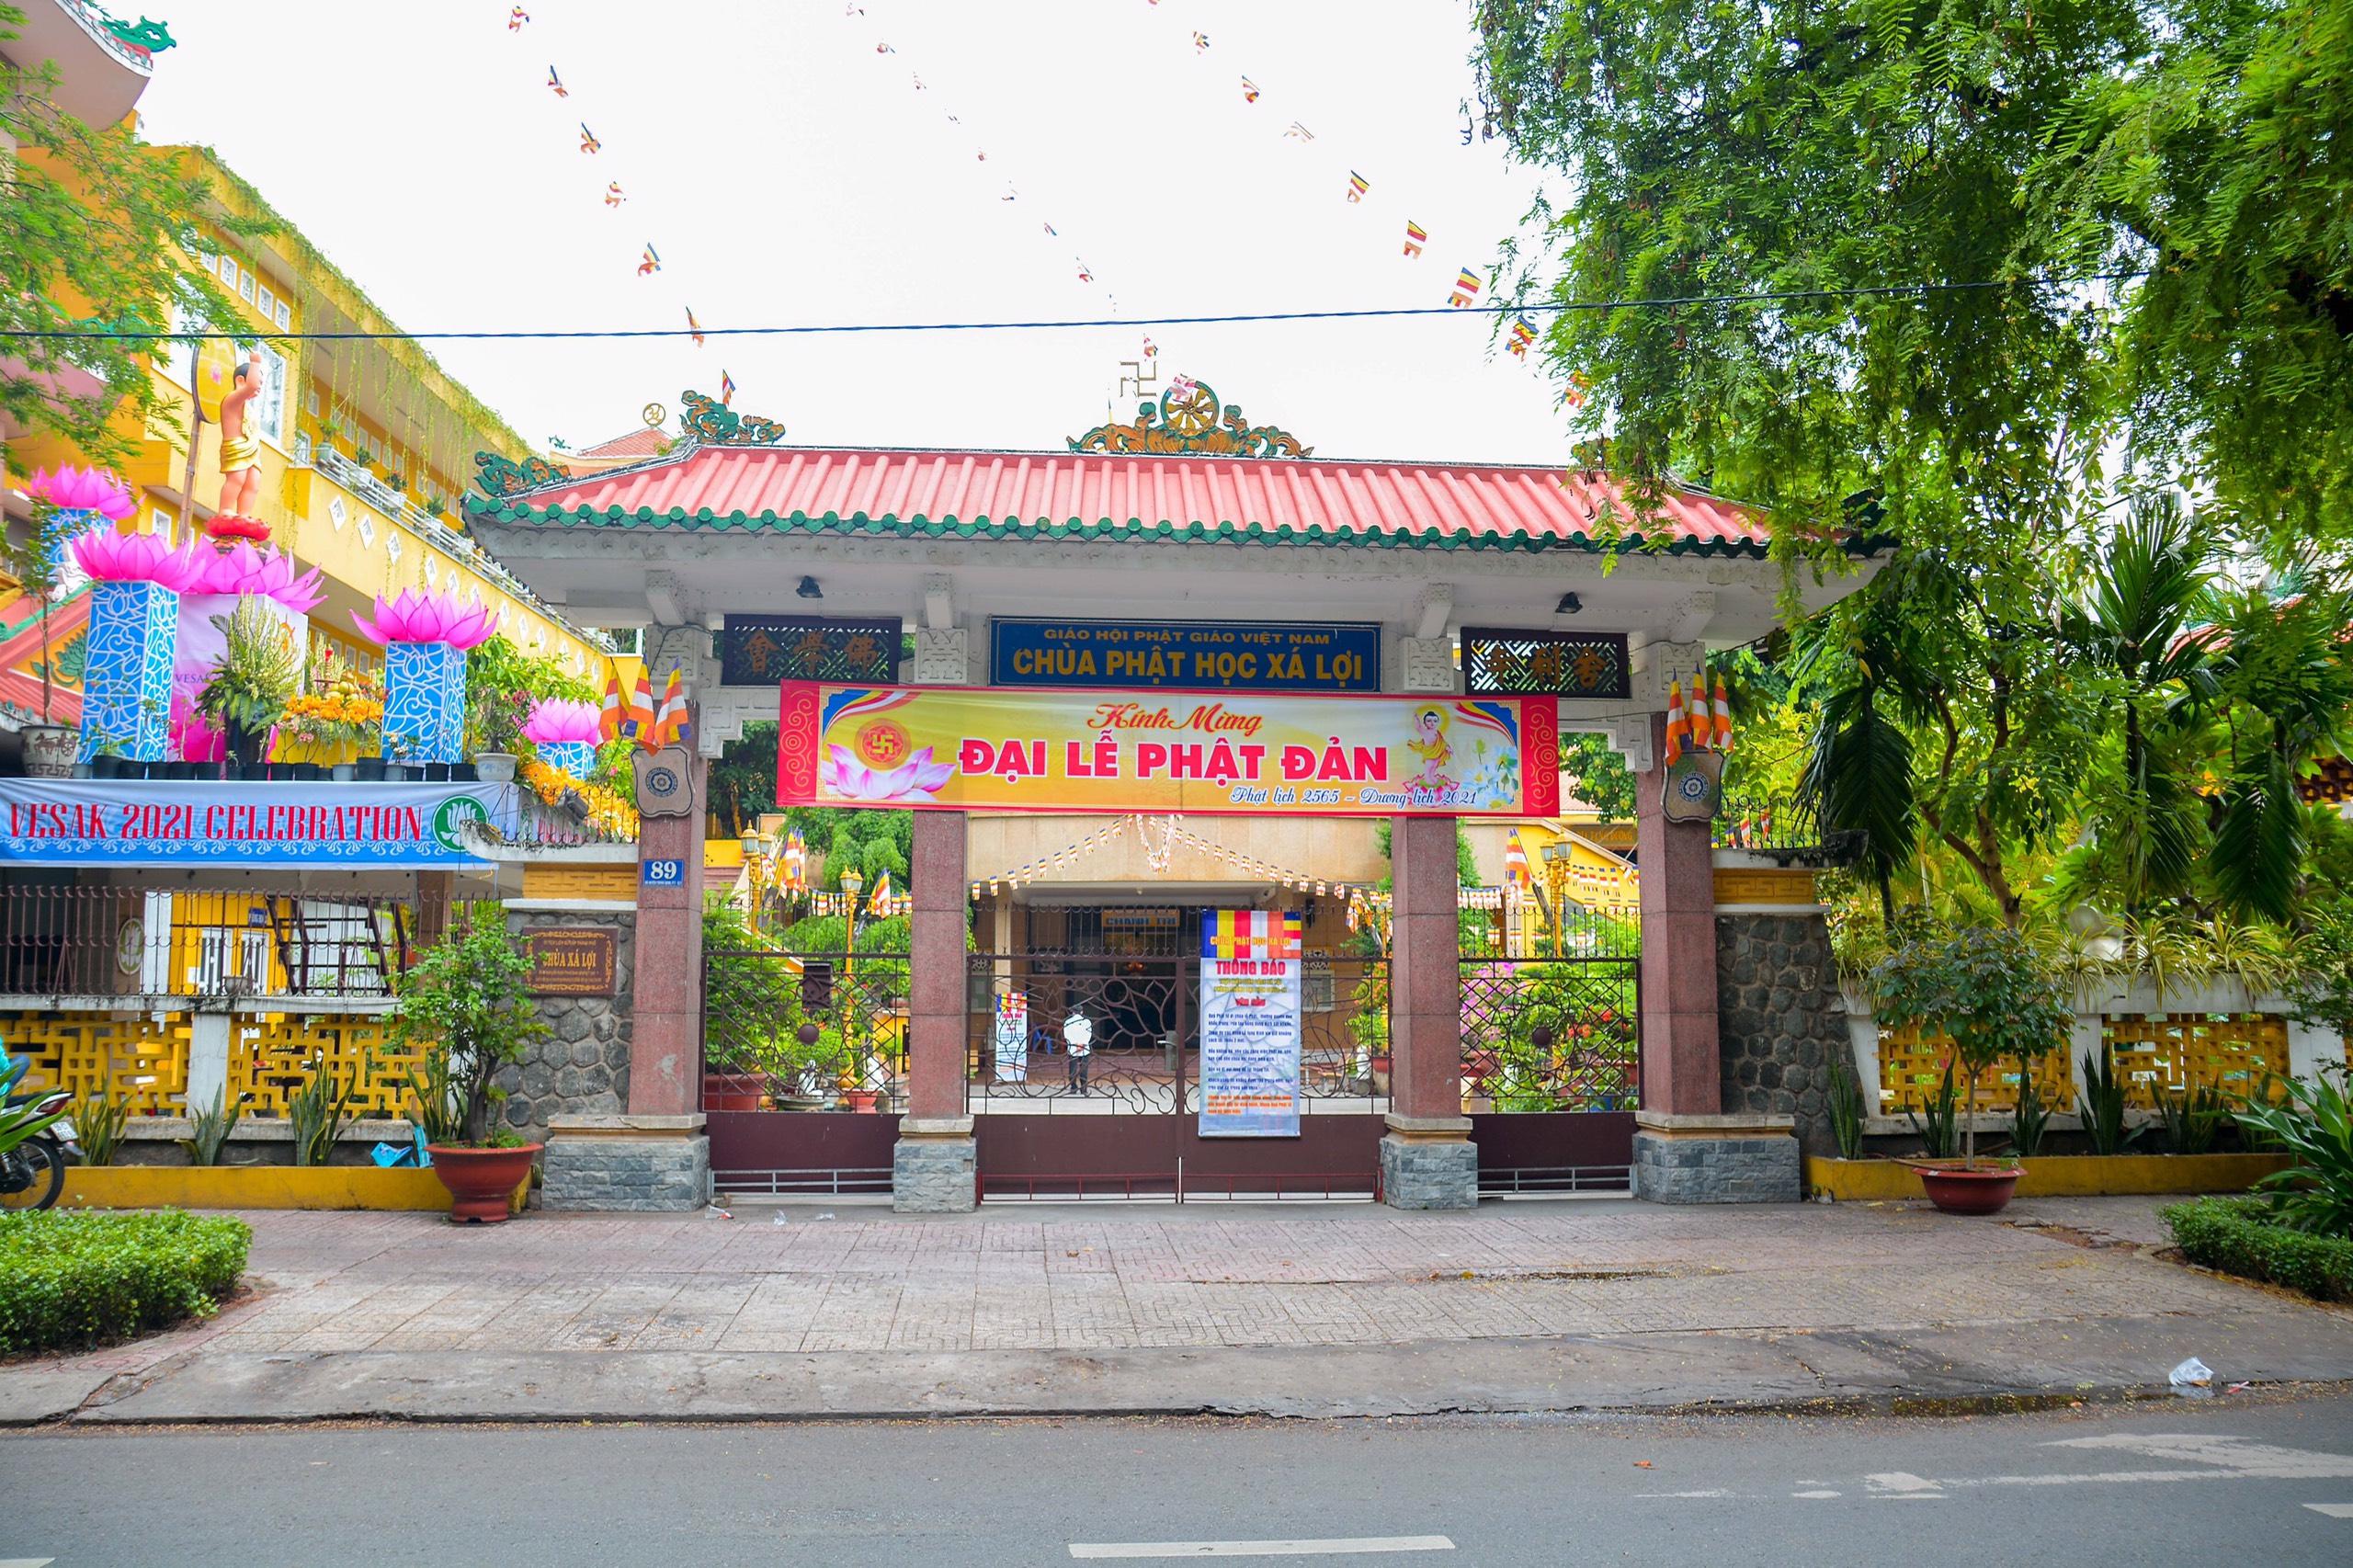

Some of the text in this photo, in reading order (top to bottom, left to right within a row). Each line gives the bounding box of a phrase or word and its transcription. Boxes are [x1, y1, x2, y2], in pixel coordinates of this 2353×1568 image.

[1044, 627, 1330, 645] GIÁO HỘI PHẬT GIÁO VIỆT NAM
[1013, 642, 1362, 687] CHÙA PHẬT HỌC XÁ LỢI
[1086, 702, 1264, 737] Kính Mừng
[958, 728, 1389, 788] ĐẠI LỄ PHẬT ĐẢN
[1231, 787, 1267, 805] Phật
[1272, 787, 1295, 806] lịch
[1302, 790, 1339, 804] 2565
[1360, 789, 1412, 809] Dương
[1412, 789, 1435, 807] lịch
[1441, 790, 1477, 805] 2021
[10, 802, 422, 842] VESAK 2021 CELEBRATION
[651, 861, 677, 880] 89
[543, 949, 597, 970] HÙA XÁ LỢI
[1216, 958, 1286, 975] THÔNG BÁO
